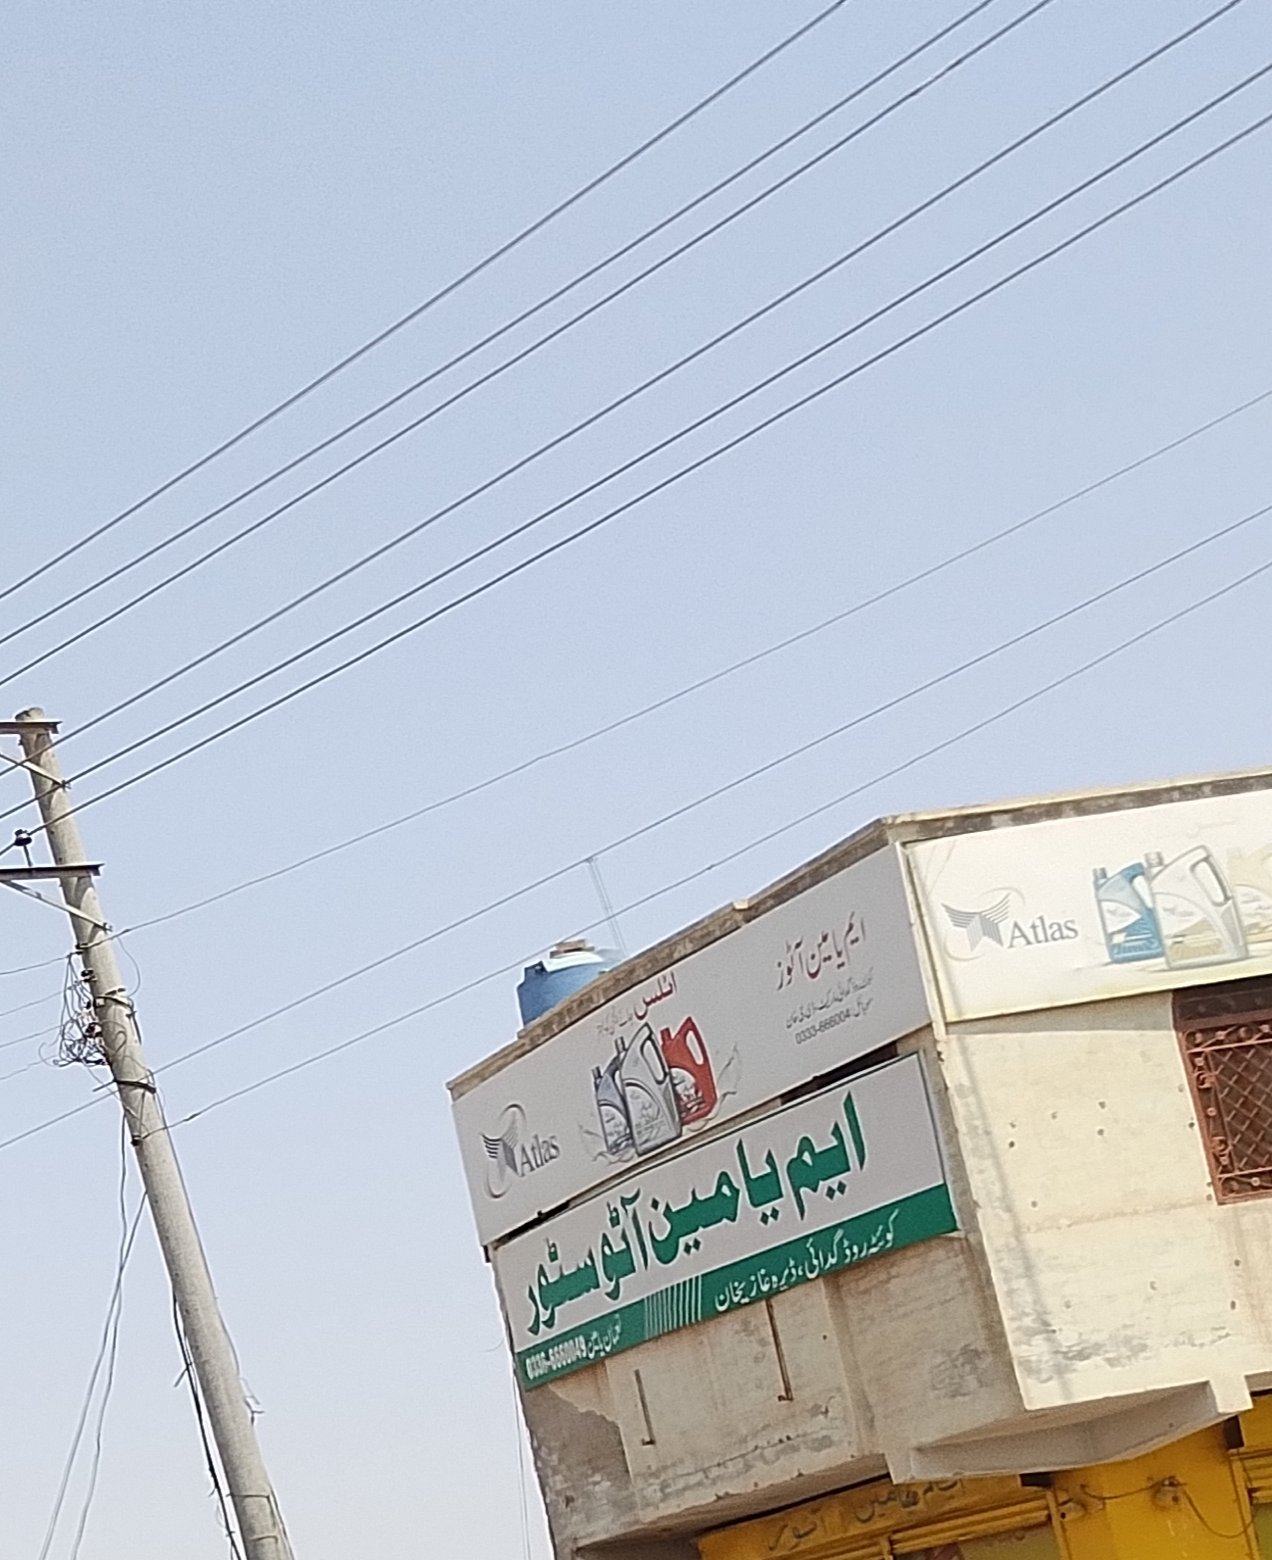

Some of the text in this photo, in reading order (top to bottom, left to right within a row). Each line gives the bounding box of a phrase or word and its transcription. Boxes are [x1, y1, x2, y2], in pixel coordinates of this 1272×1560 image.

[1007, 916, 1079, 949] Atlas
[519, 1133, 560, 1178] Atlas
[786, 1089, 866, 1222] ایم
[601, 1186, 649, 1301] آٹو
